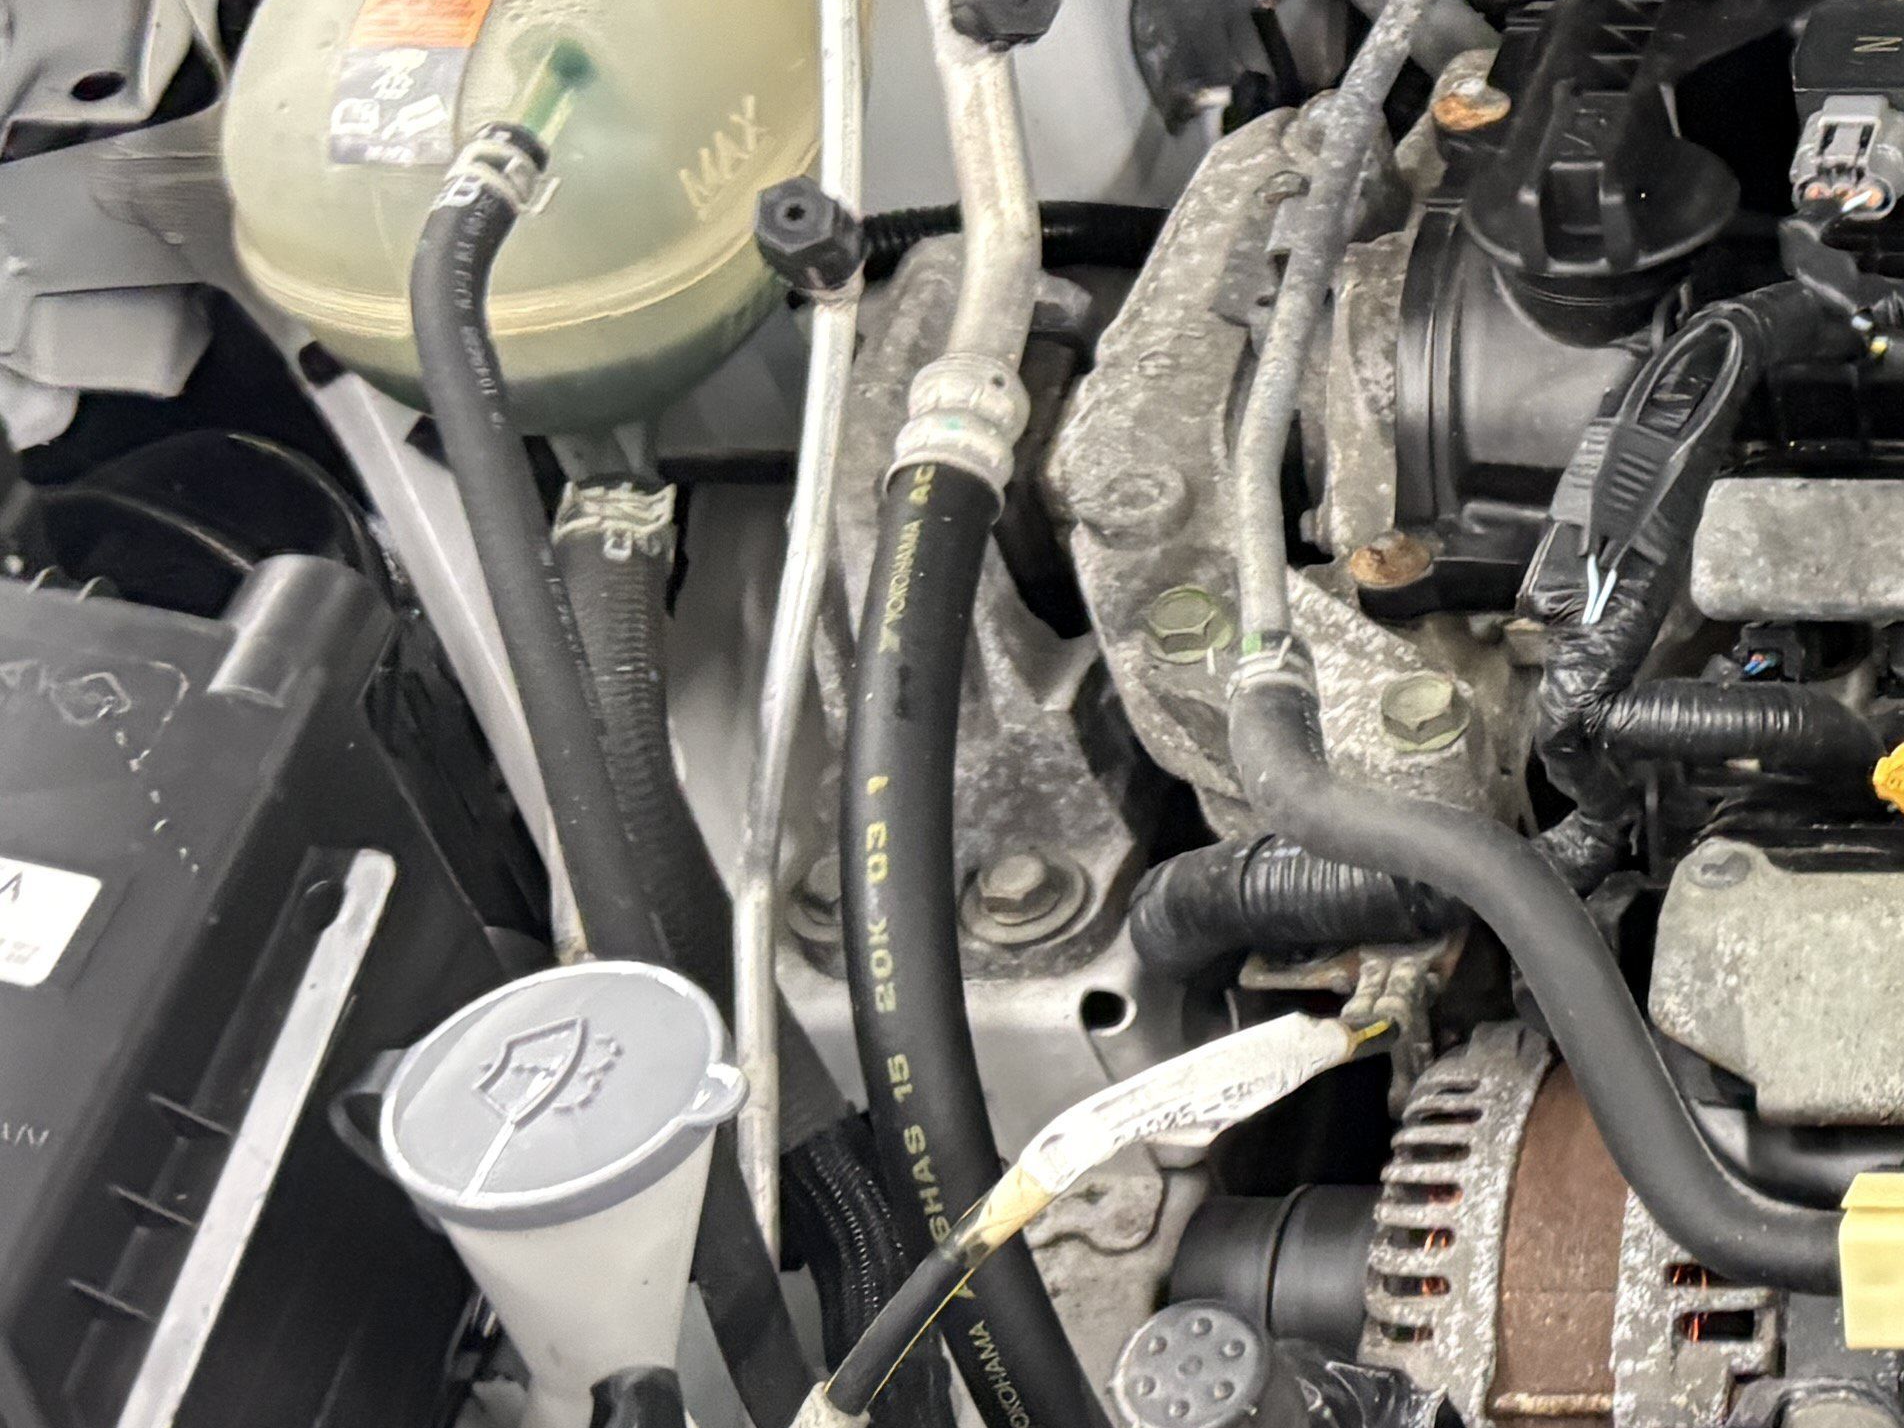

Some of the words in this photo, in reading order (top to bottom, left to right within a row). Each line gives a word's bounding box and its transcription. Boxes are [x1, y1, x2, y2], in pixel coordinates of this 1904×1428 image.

[678, 94, 778, 215] MAX
[864, 819, 890, 885] 03
[865, 914, 899, 1015] 20K
[886, 1052, 915, 1103] 15
